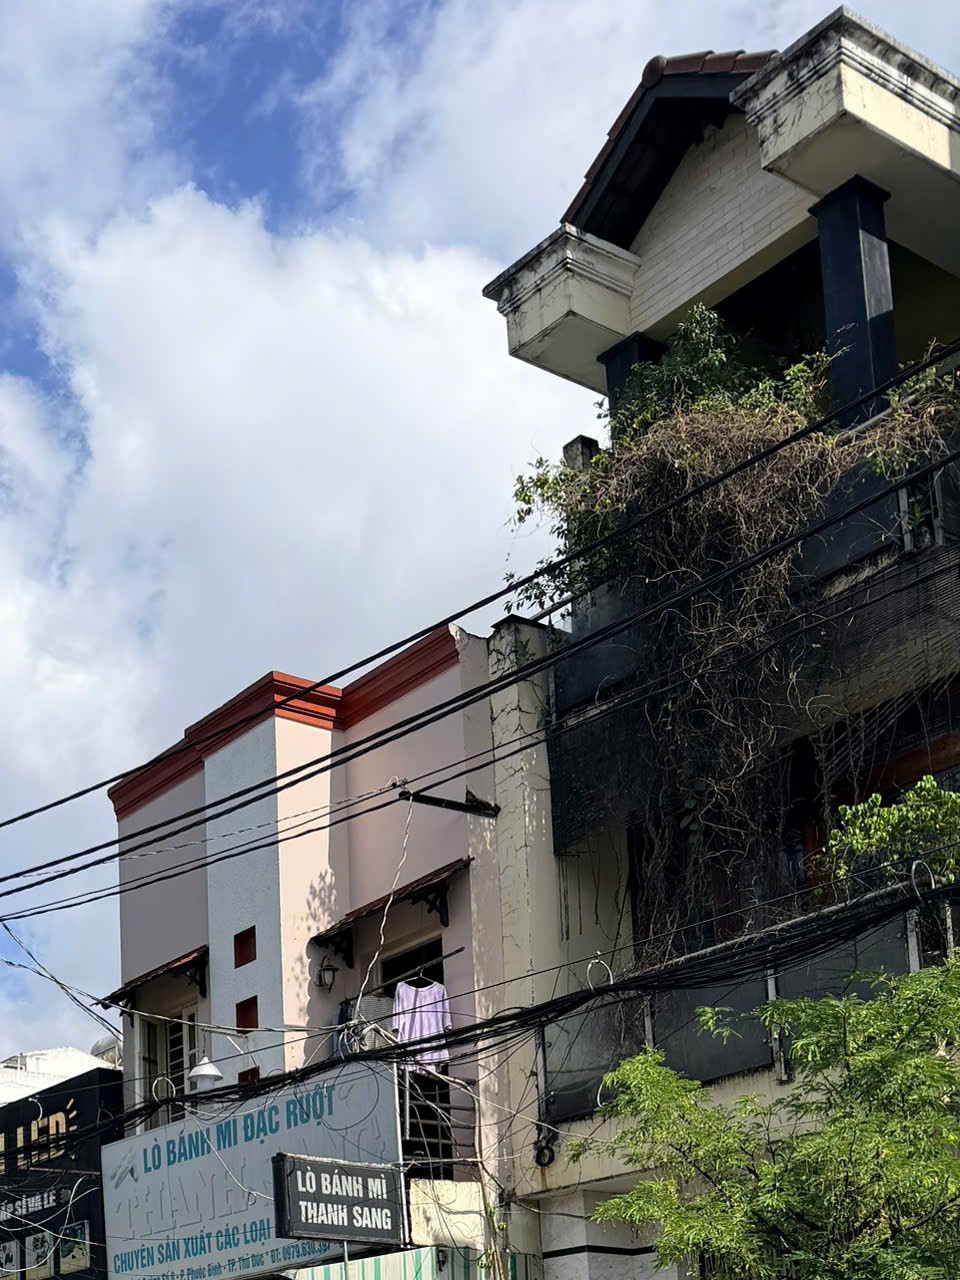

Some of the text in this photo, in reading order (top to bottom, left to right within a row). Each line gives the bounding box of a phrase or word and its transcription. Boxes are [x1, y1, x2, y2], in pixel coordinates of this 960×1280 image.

[143, 1138, 162, 1174] LÒ
[167, 1129, 211, 1167] BÁNH
[286, 1084, 336, 1129] RUỘT
[296, 1166, 388, 1200] LÒ BÁNH MÌ
[299, 1201, 392, 1230] THANH SANG
[114, 1217, 271, 1273] CHUYÊN SẢN XUẤT CÁC LOẠI
